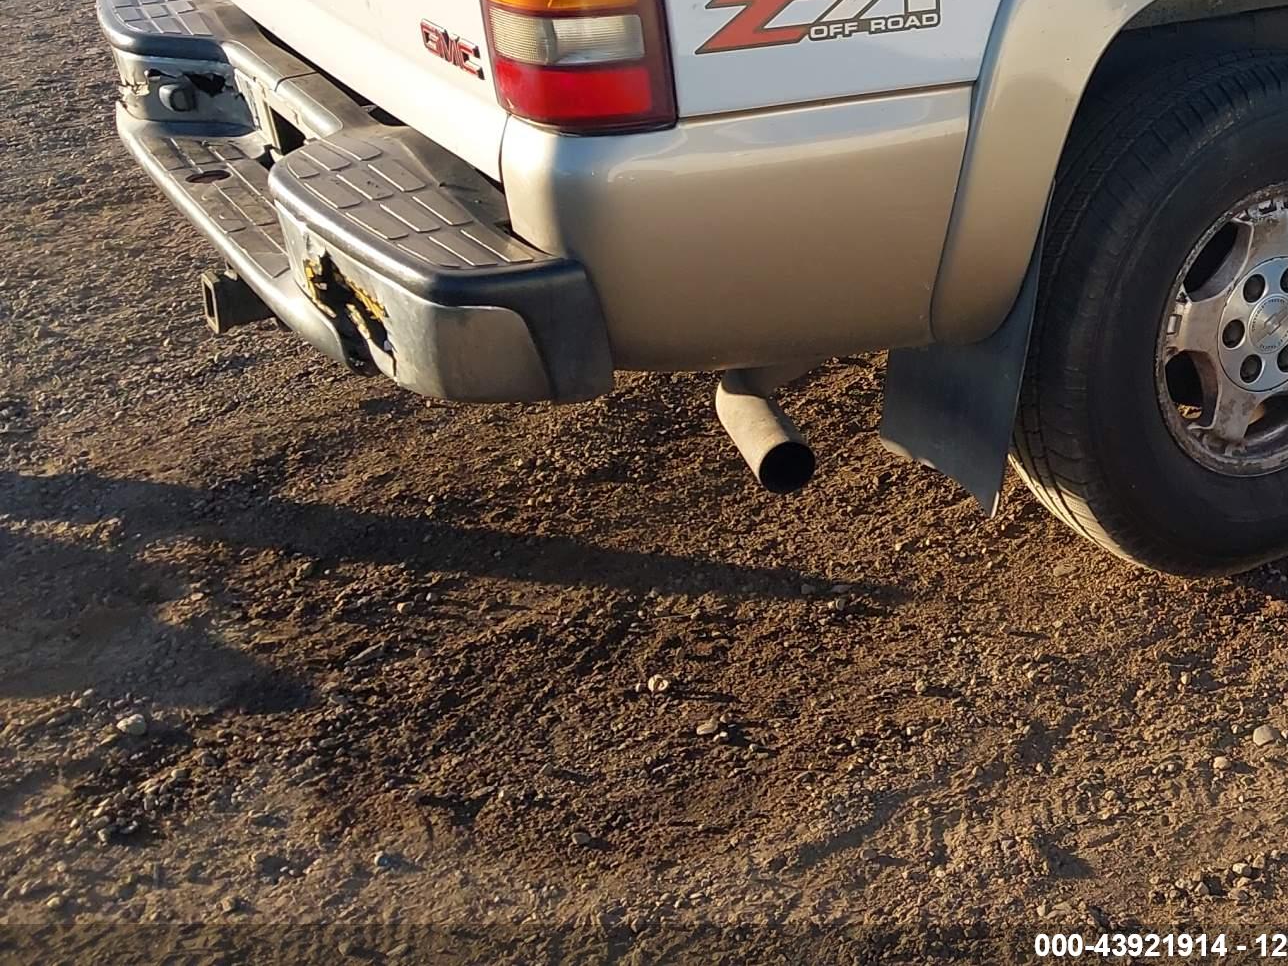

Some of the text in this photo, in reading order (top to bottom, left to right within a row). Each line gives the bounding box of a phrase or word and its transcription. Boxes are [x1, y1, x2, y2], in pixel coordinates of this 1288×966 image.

[809, 13, 939, 39] OFF ROAD
[419, 18, 485, 80] GMC
